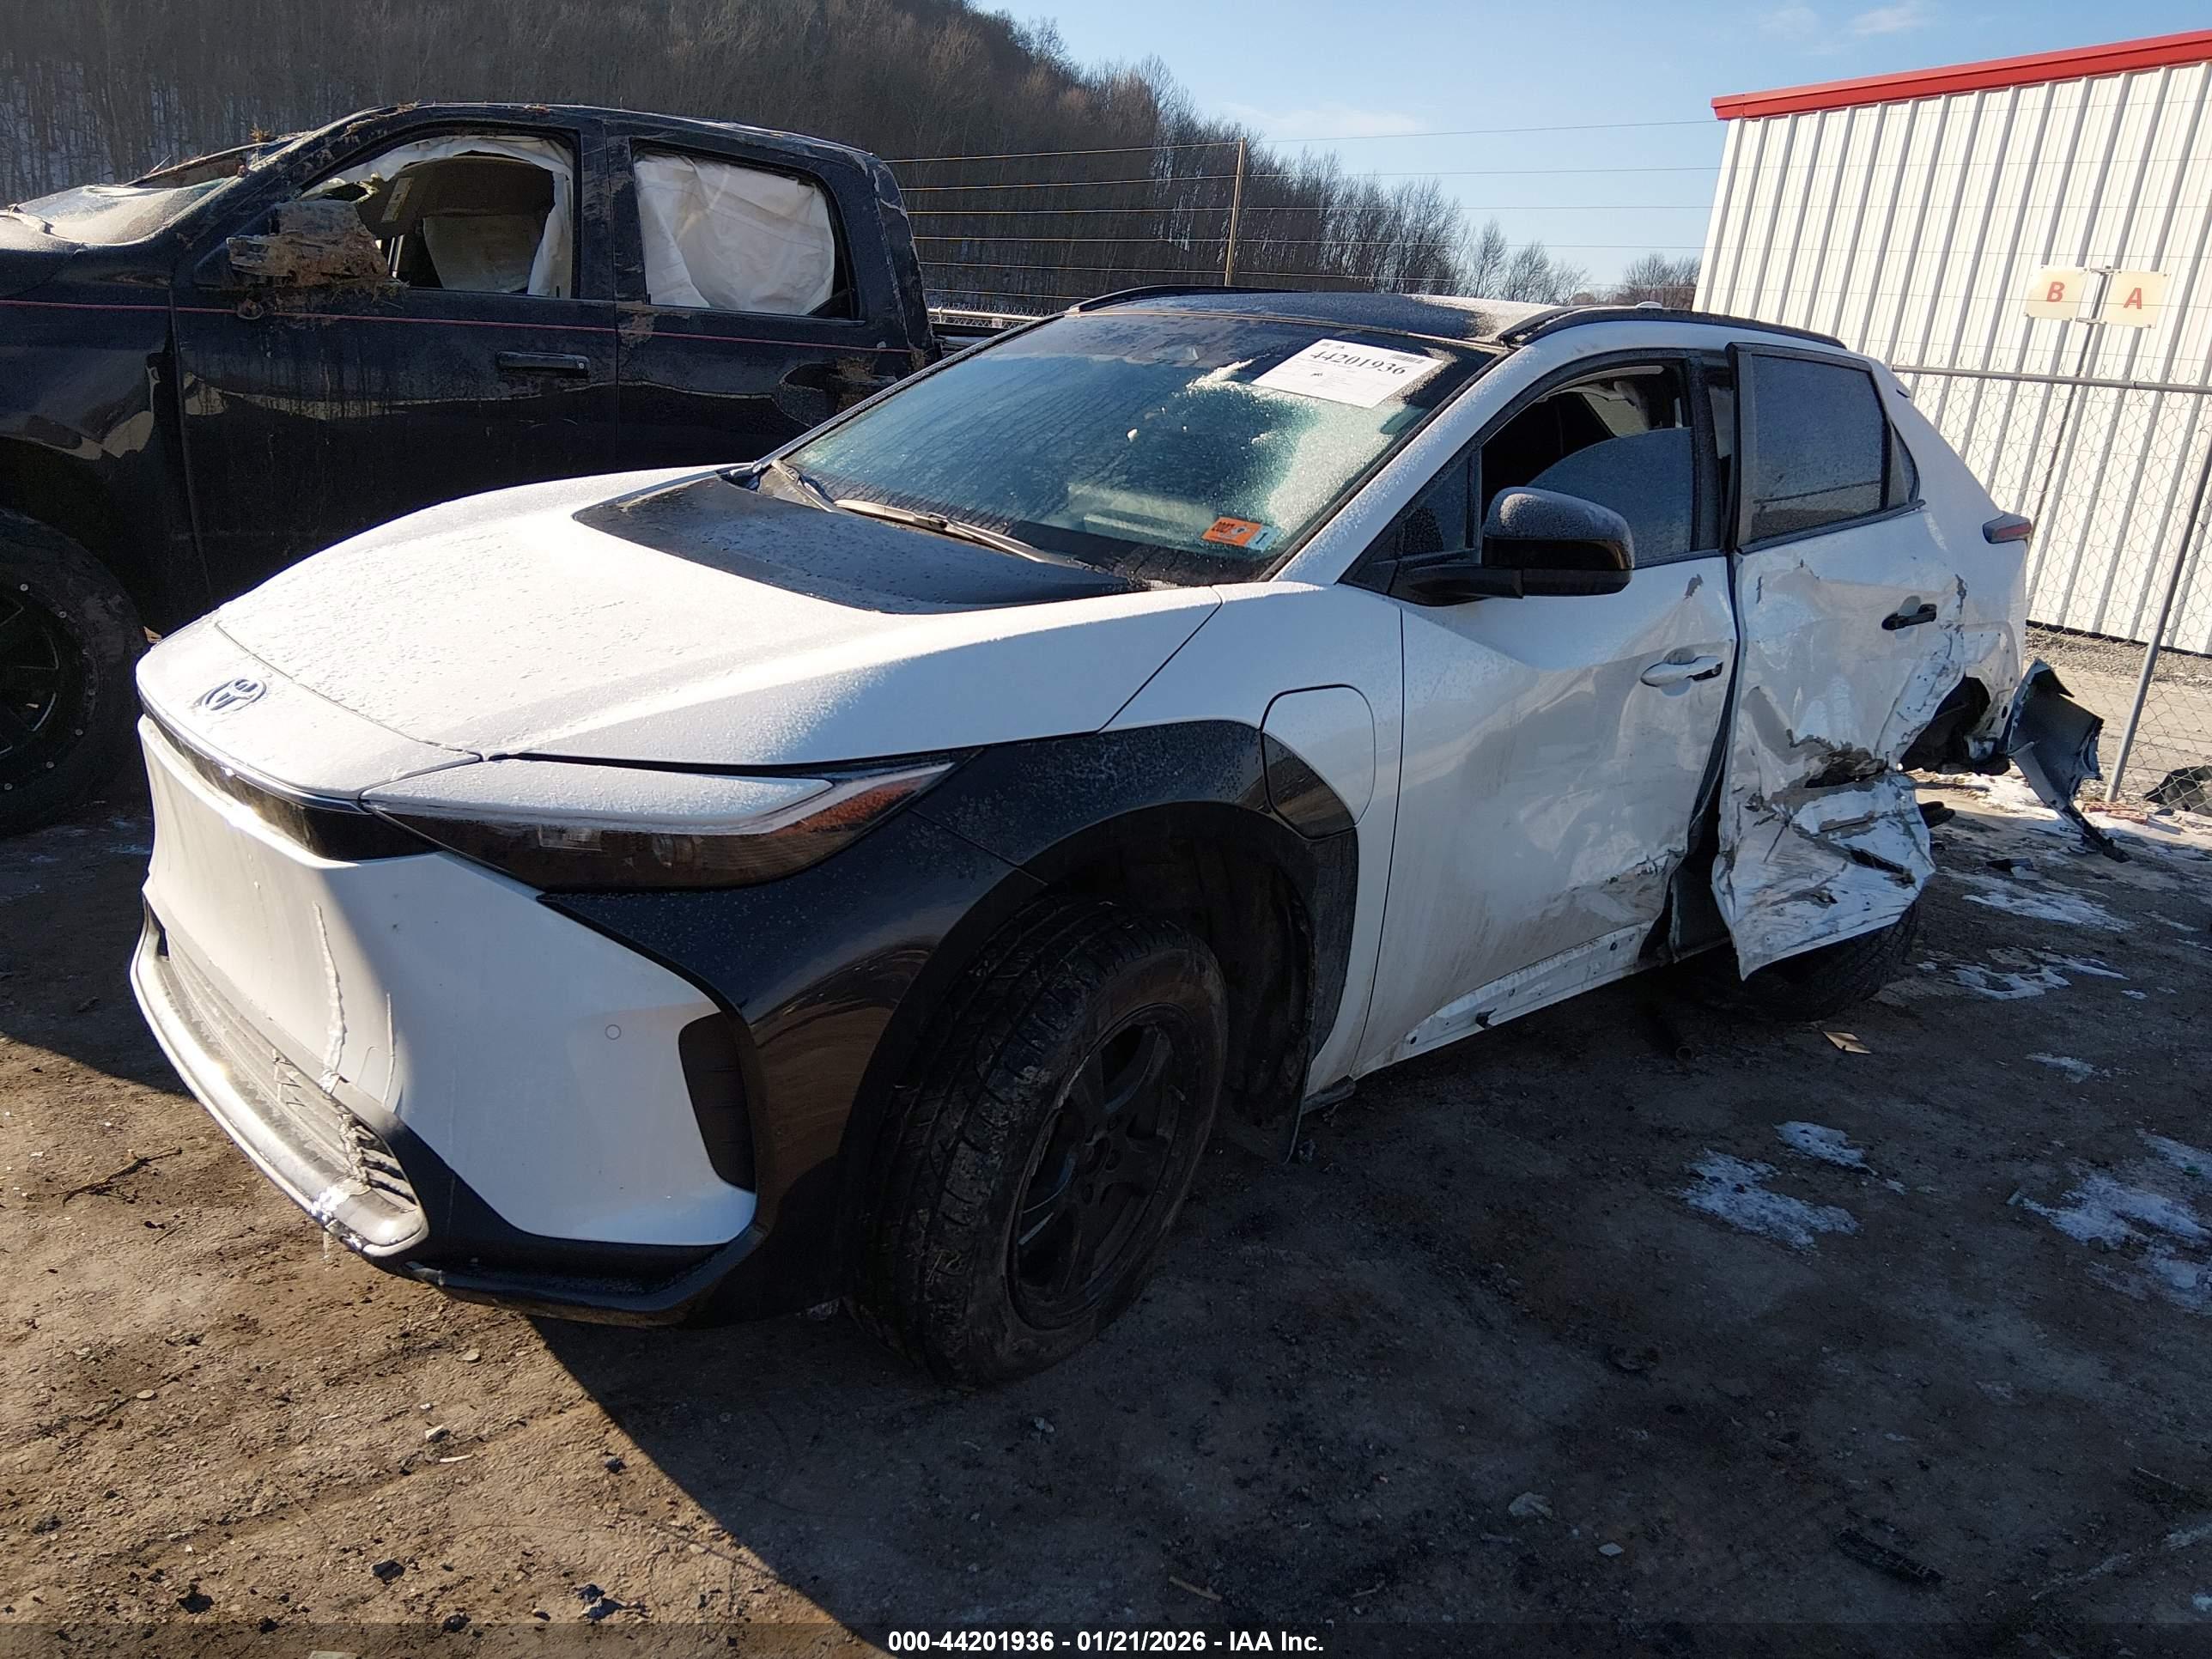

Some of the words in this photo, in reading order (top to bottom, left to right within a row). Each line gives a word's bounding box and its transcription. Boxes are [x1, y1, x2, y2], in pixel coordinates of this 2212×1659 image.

[2047, 282, 2064, 302] B
[2124, 288, 2142, 309] A
[1310, 350, 1408, 374] 44201936
